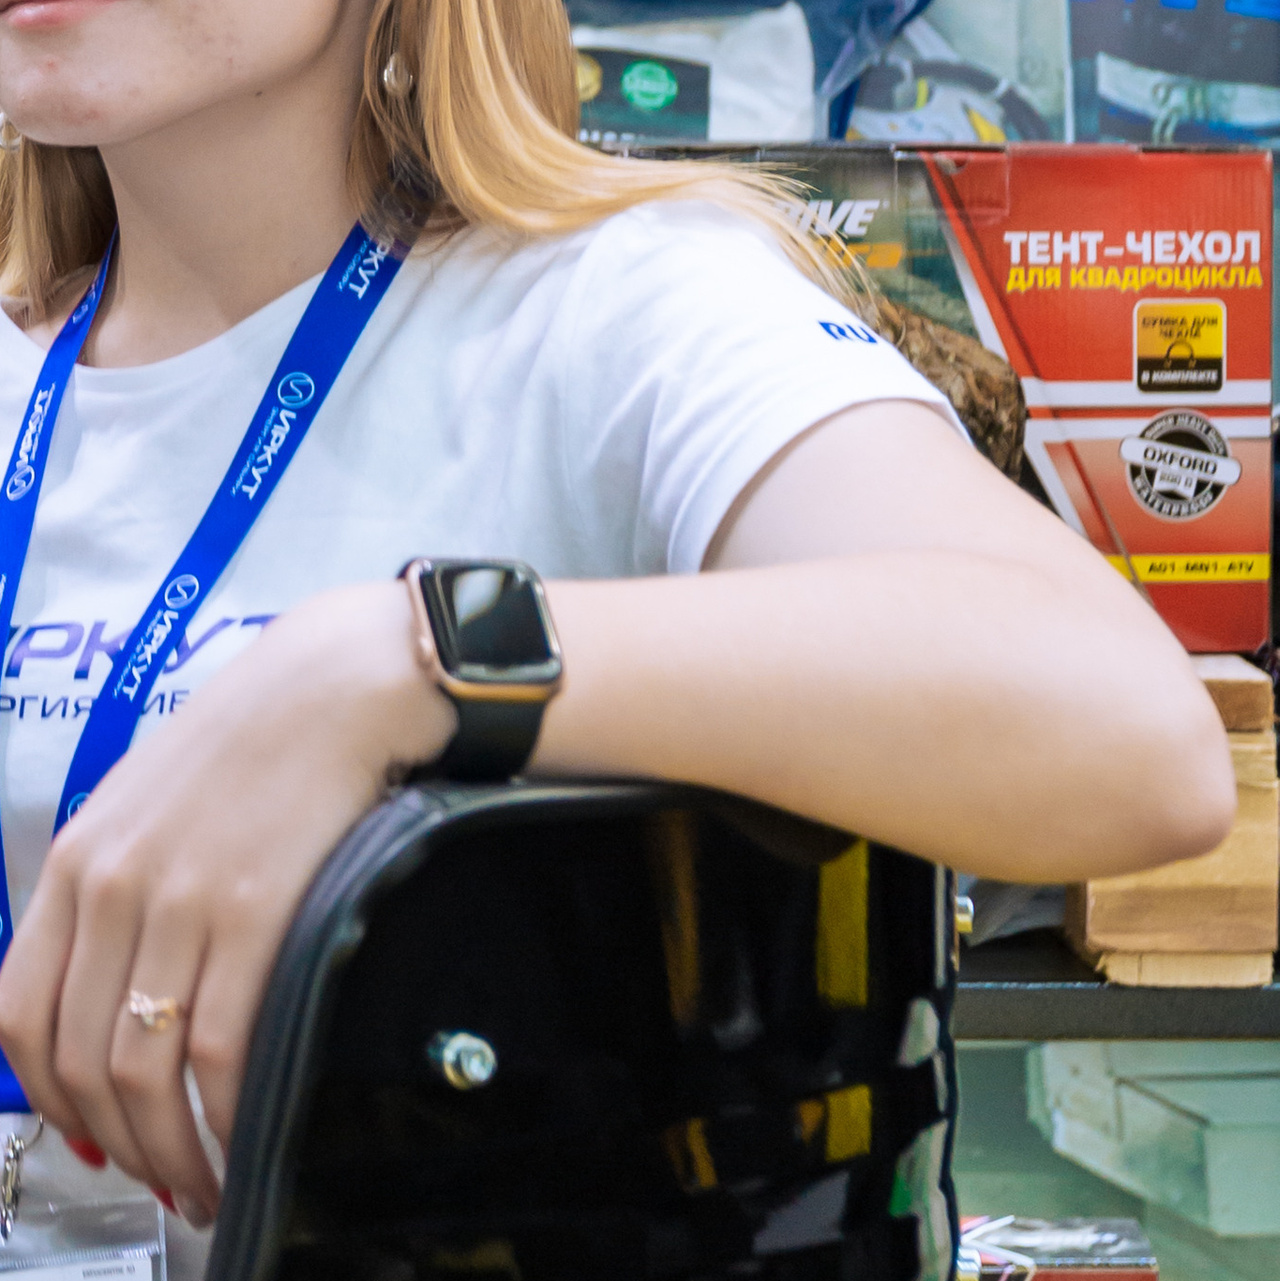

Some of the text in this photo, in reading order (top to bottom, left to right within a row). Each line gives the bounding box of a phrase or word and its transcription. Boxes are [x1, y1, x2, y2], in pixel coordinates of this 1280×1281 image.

[1006, 265, 1264, 294] ДЛЯ КВАДРОЦИКЛА
[241, 408, 297, 501] ИРКУТ
[1143, 445, 1219, 476] OXFORD
